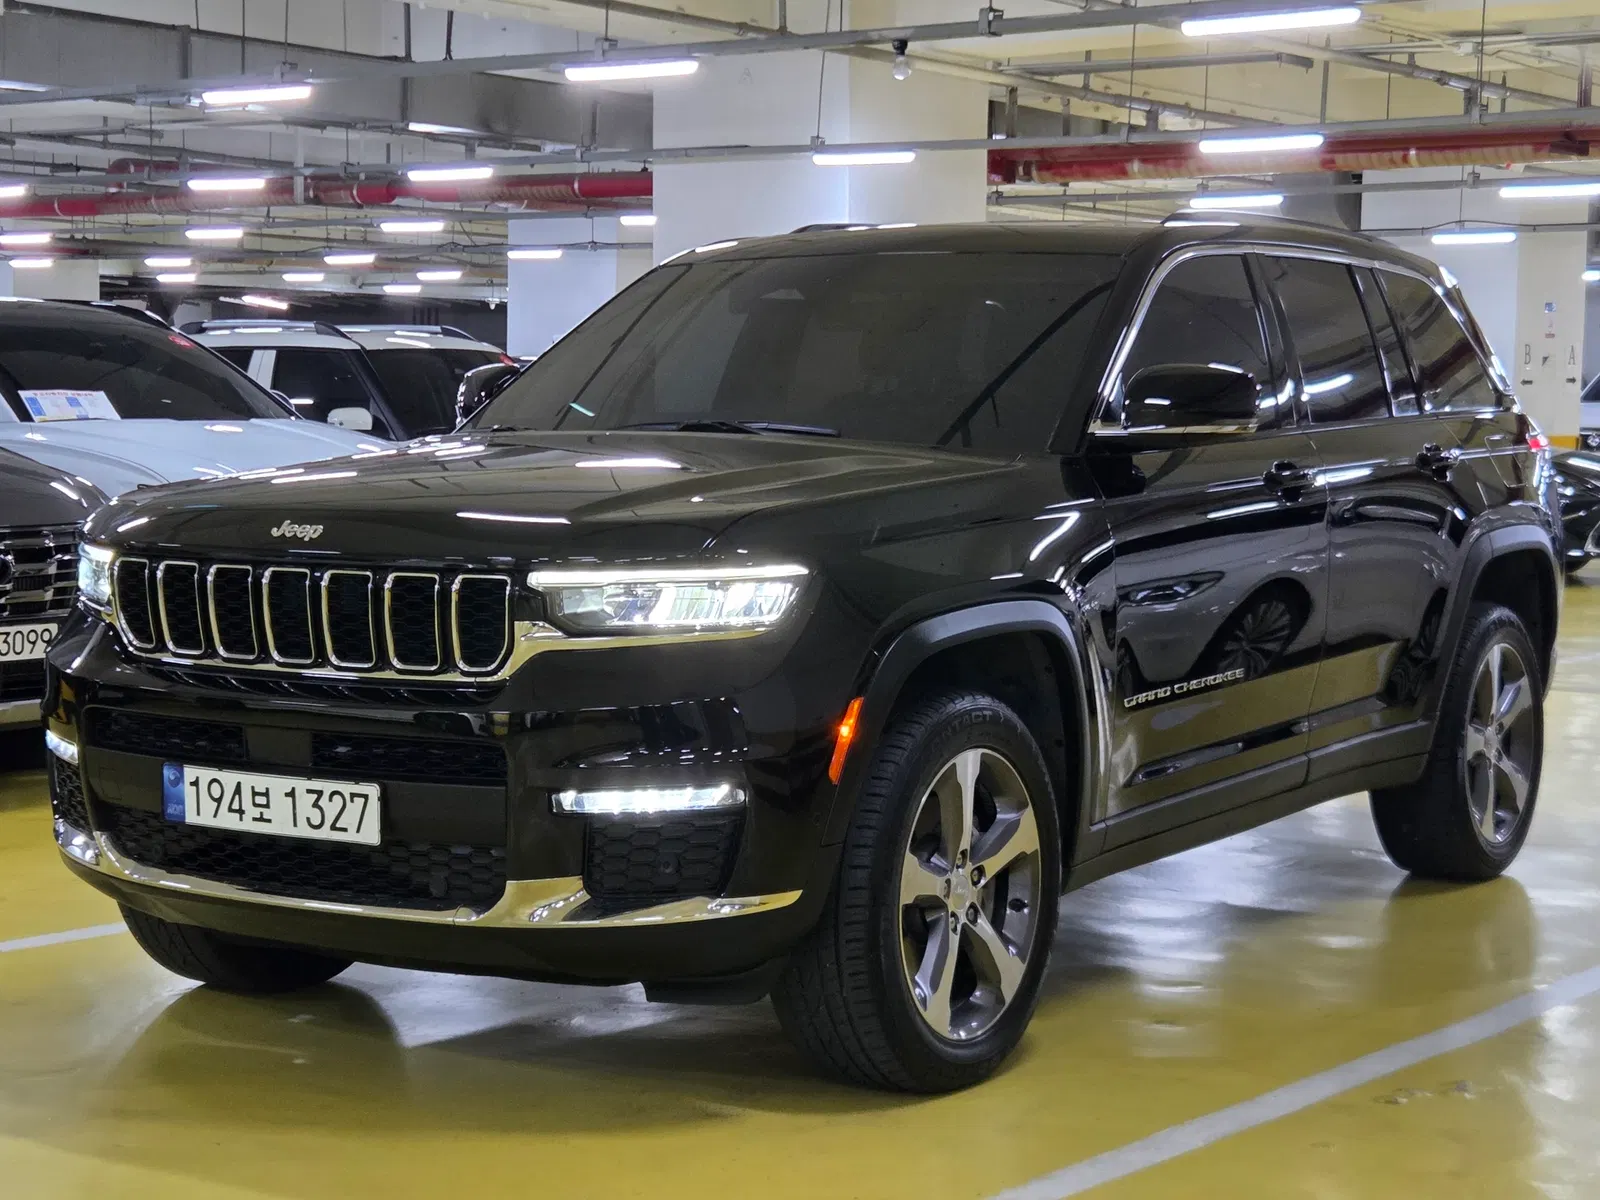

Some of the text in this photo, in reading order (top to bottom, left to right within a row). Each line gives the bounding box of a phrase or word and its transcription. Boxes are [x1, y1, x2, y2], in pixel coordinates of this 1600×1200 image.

[1524, 344, 1531, 365] B
[1568, 345, 1576, 365] A
[270, 519, 324, 541] Jeep
[0, 628, 52, 657] 3099
[1124, 668, 1245, 708] GRAND CHEROKEE
[189, 775, 370, 834] 194보 1327
